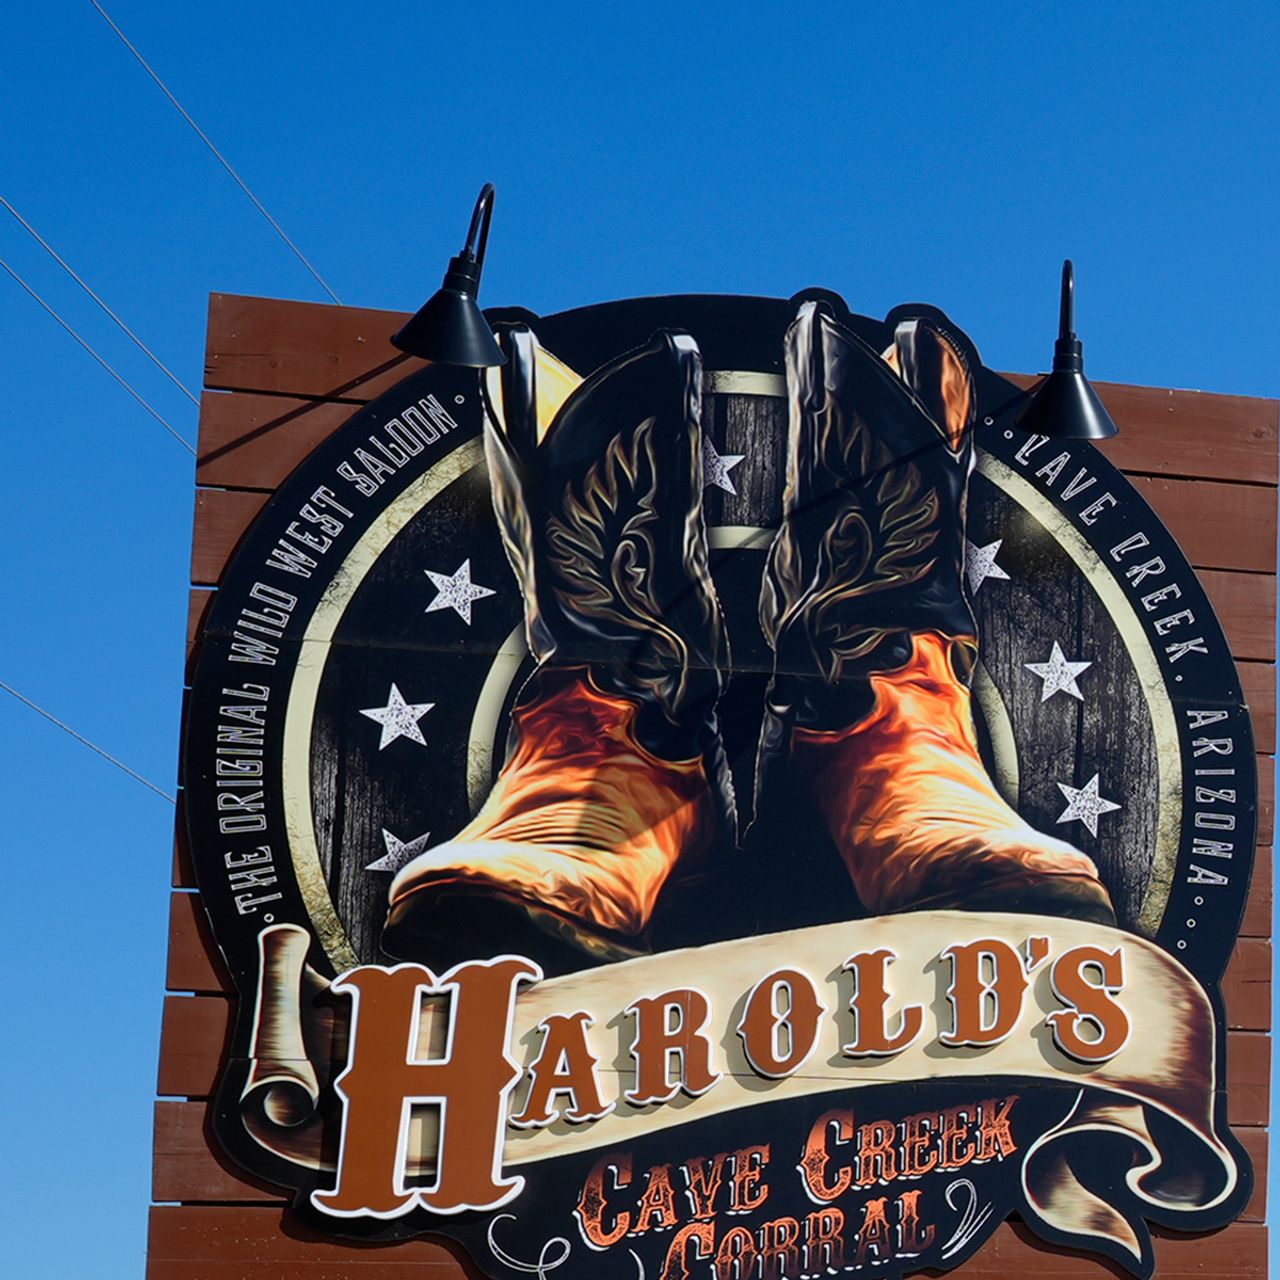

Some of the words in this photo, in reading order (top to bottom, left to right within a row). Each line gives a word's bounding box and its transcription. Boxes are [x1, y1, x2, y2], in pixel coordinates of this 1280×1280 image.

[336, 393, 459, 497] SALOON
[265, 484, 355, 580] WEST
[228, 581, 299, 666] WILD
[1014, 434, 1118, 526] CAVE
[1186, 708, 1236, 886] ARIZONA
[216, 681, 271, 833] ORIGINAL
[225, 845, 278, 915] THE
[310, 935, 1132, 1219] HAROLD'S
[573, 1143, 772, 1251] CAVE
[796, 1095, 1021, 1204] CREEK
